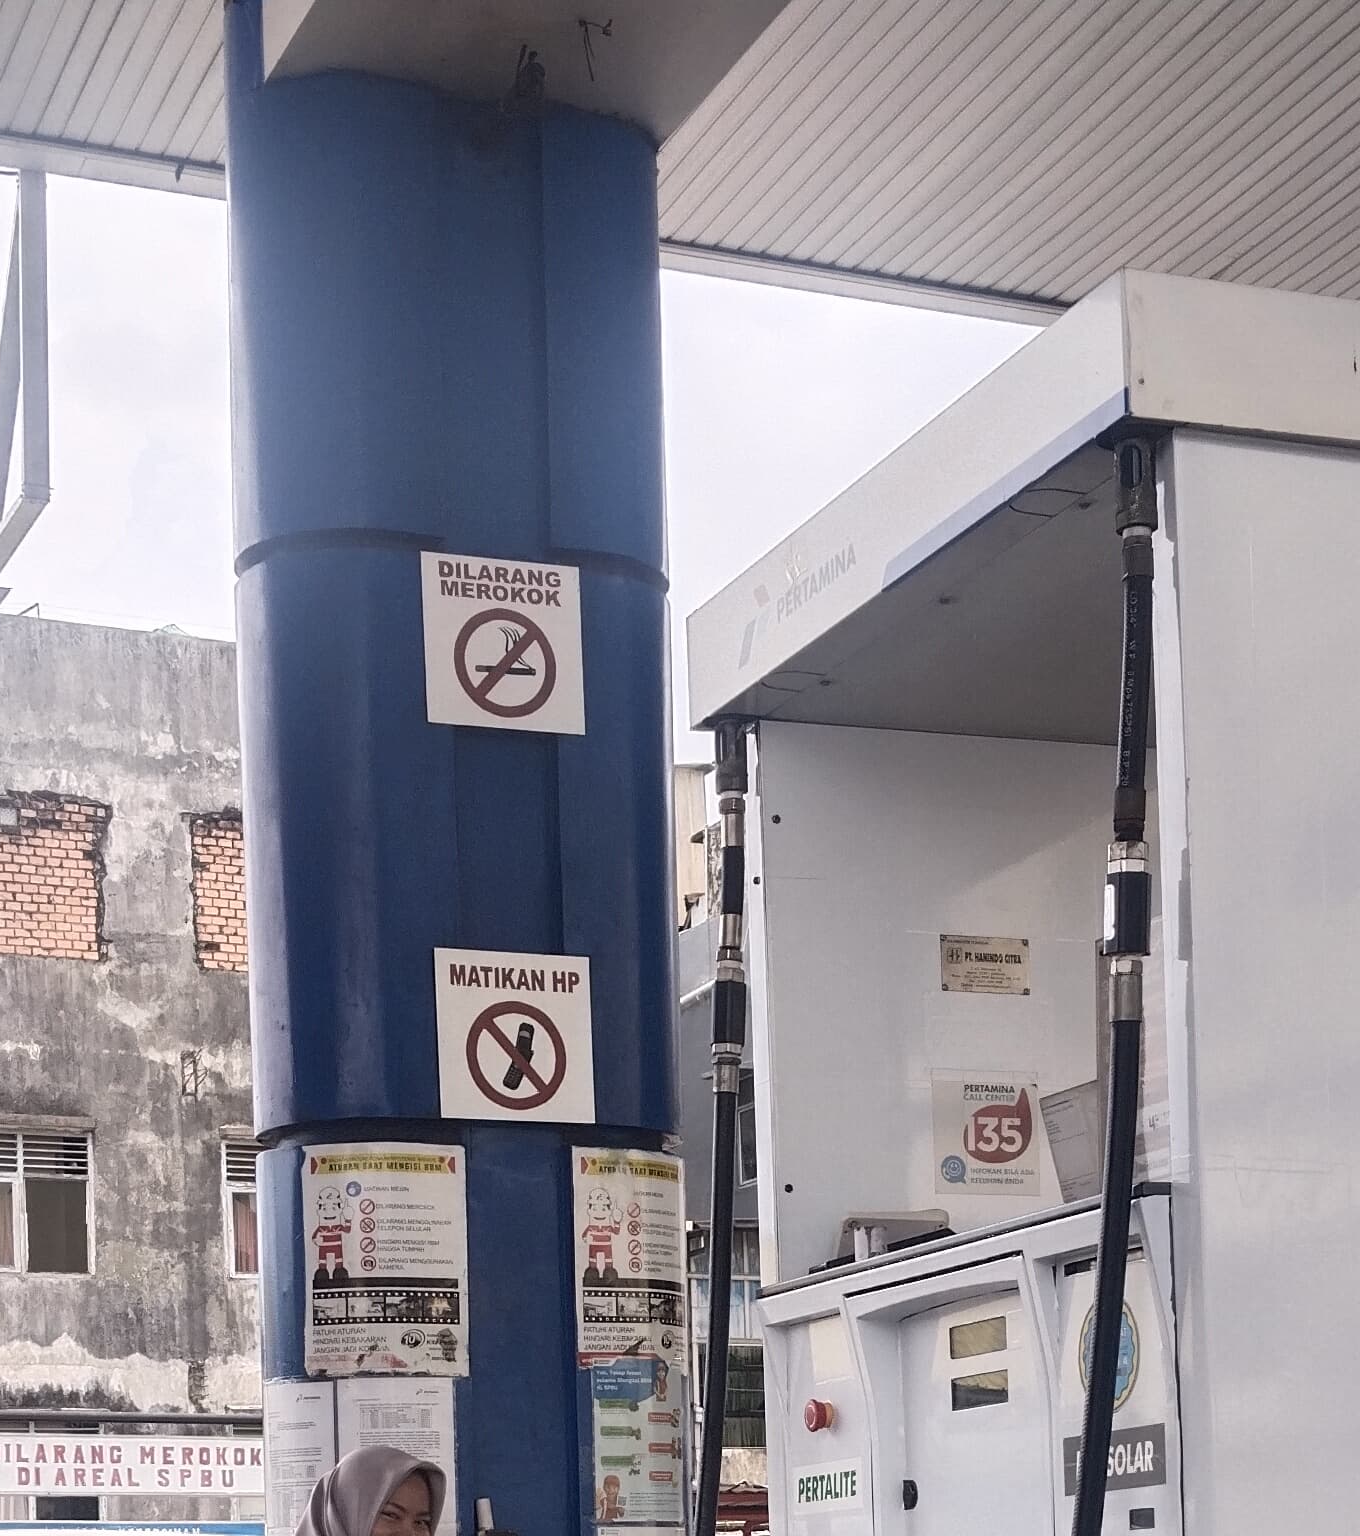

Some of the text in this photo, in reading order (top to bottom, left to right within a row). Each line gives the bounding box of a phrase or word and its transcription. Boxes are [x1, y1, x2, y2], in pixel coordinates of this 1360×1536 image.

[438, 560, 561, 588] DILARANG
[776, 543, 857, 625] PERTAMINA
[440, 579, 561, 607] MEROKOK
[449, 963, 580, 993] MATIKAN HP
[963, 1083, 1016, 1095] PERTAMINA
[963, 1093, 988, 1102] CALL
[967, 1115, 1023, 1153] 135
[139, 1445, 263, 1467] MEROKOK
[17, 1466, 236, 1488] DI AREAL SPBU
[797, 1469, 857, 1504] PERTALITE
